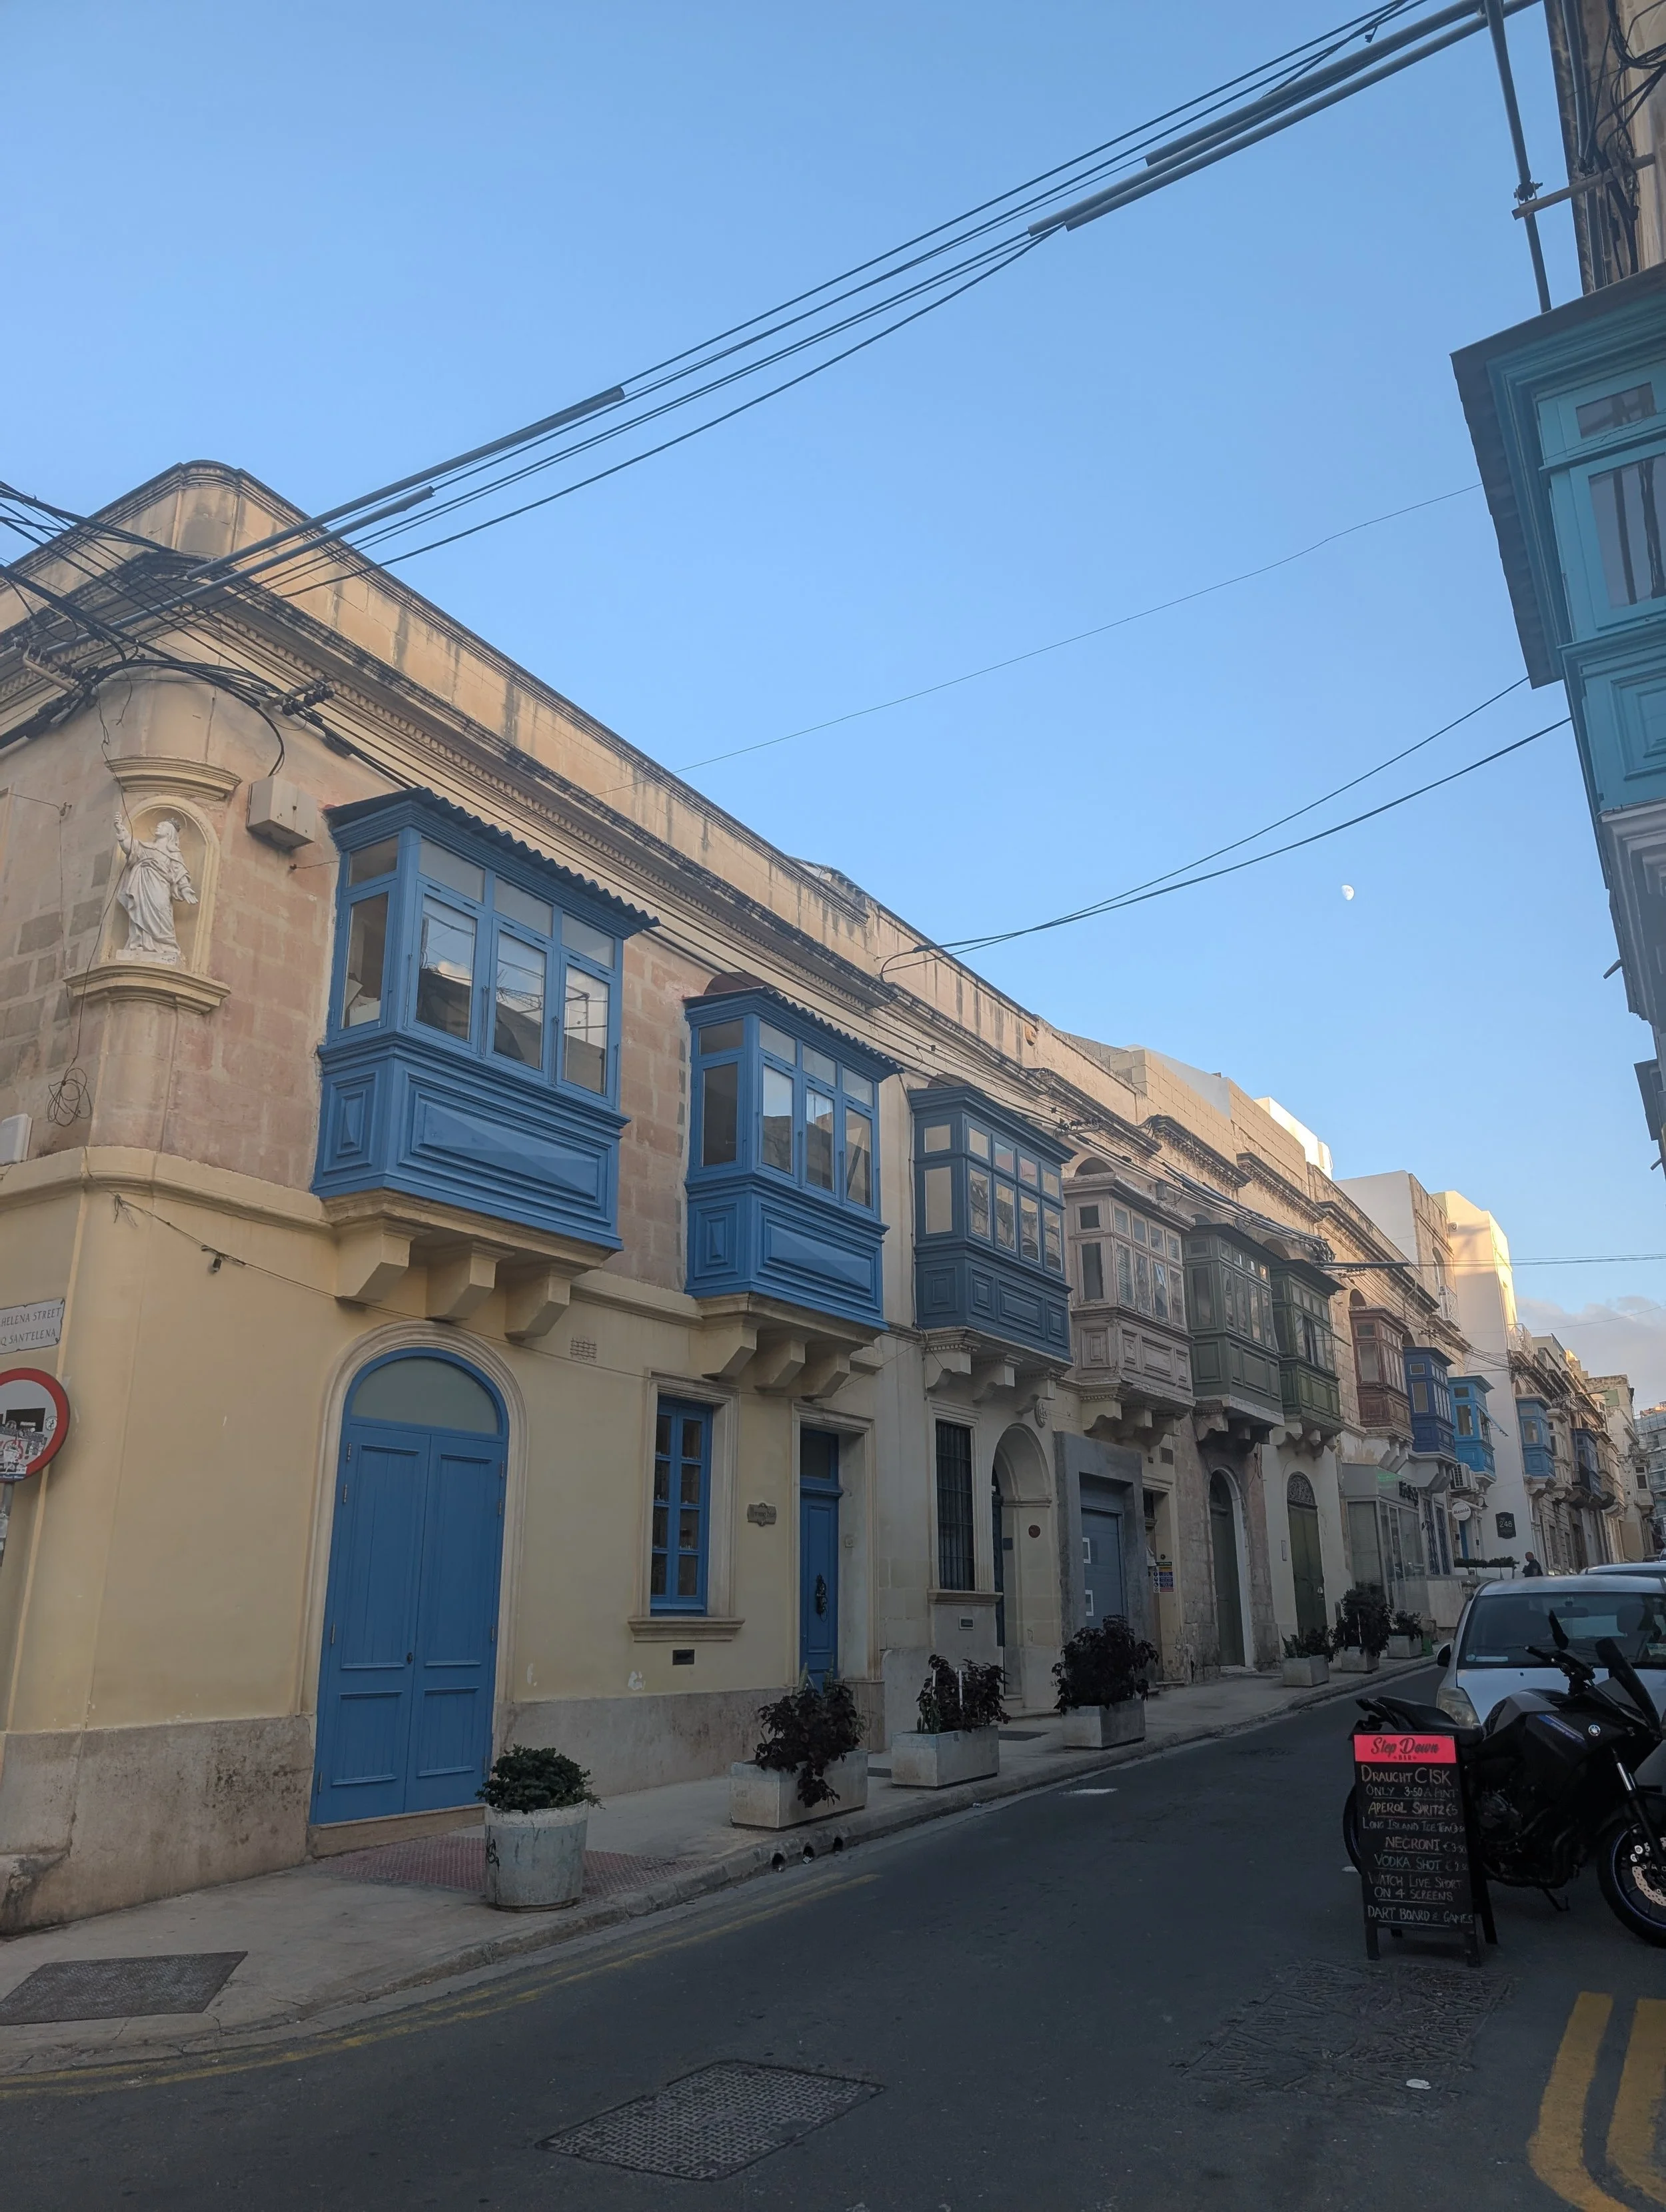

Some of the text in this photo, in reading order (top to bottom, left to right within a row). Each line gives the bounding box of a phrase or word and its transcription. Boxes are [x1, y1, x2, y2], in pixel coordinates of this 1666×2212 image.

[1, 1307, 62, 1327] HELENA STREET
[1371, 1737, 1439, 1758] Step Down
[1415, 1767, 1453, 1786] CISK
[1365, 1784, 1395, 1796] ONLY
[1367, 1802, 1407, 1814] APEROL
[1362, 1816, 1384, 1830] LONG
[1387, 1819, 1419, 1832] ISLAND
[1421, 1820, 1437, 1832] ICE
[1373, 1853, 1411, 1868] VODKA
[1415, 1856, 1442, 1871] SHOT
[1367, 1871, 1404, 1887] WATCH
[1409, 1874, 1431, 1888] LIVE
[1373, 1886, 1453, 1902] ON 4 SCREENS
[1367, 1906, 1397, 1920] DART
[1399, 1908, 1430, 1921] BOARD
[1443, 1910, 1473, 1924] GAMES
